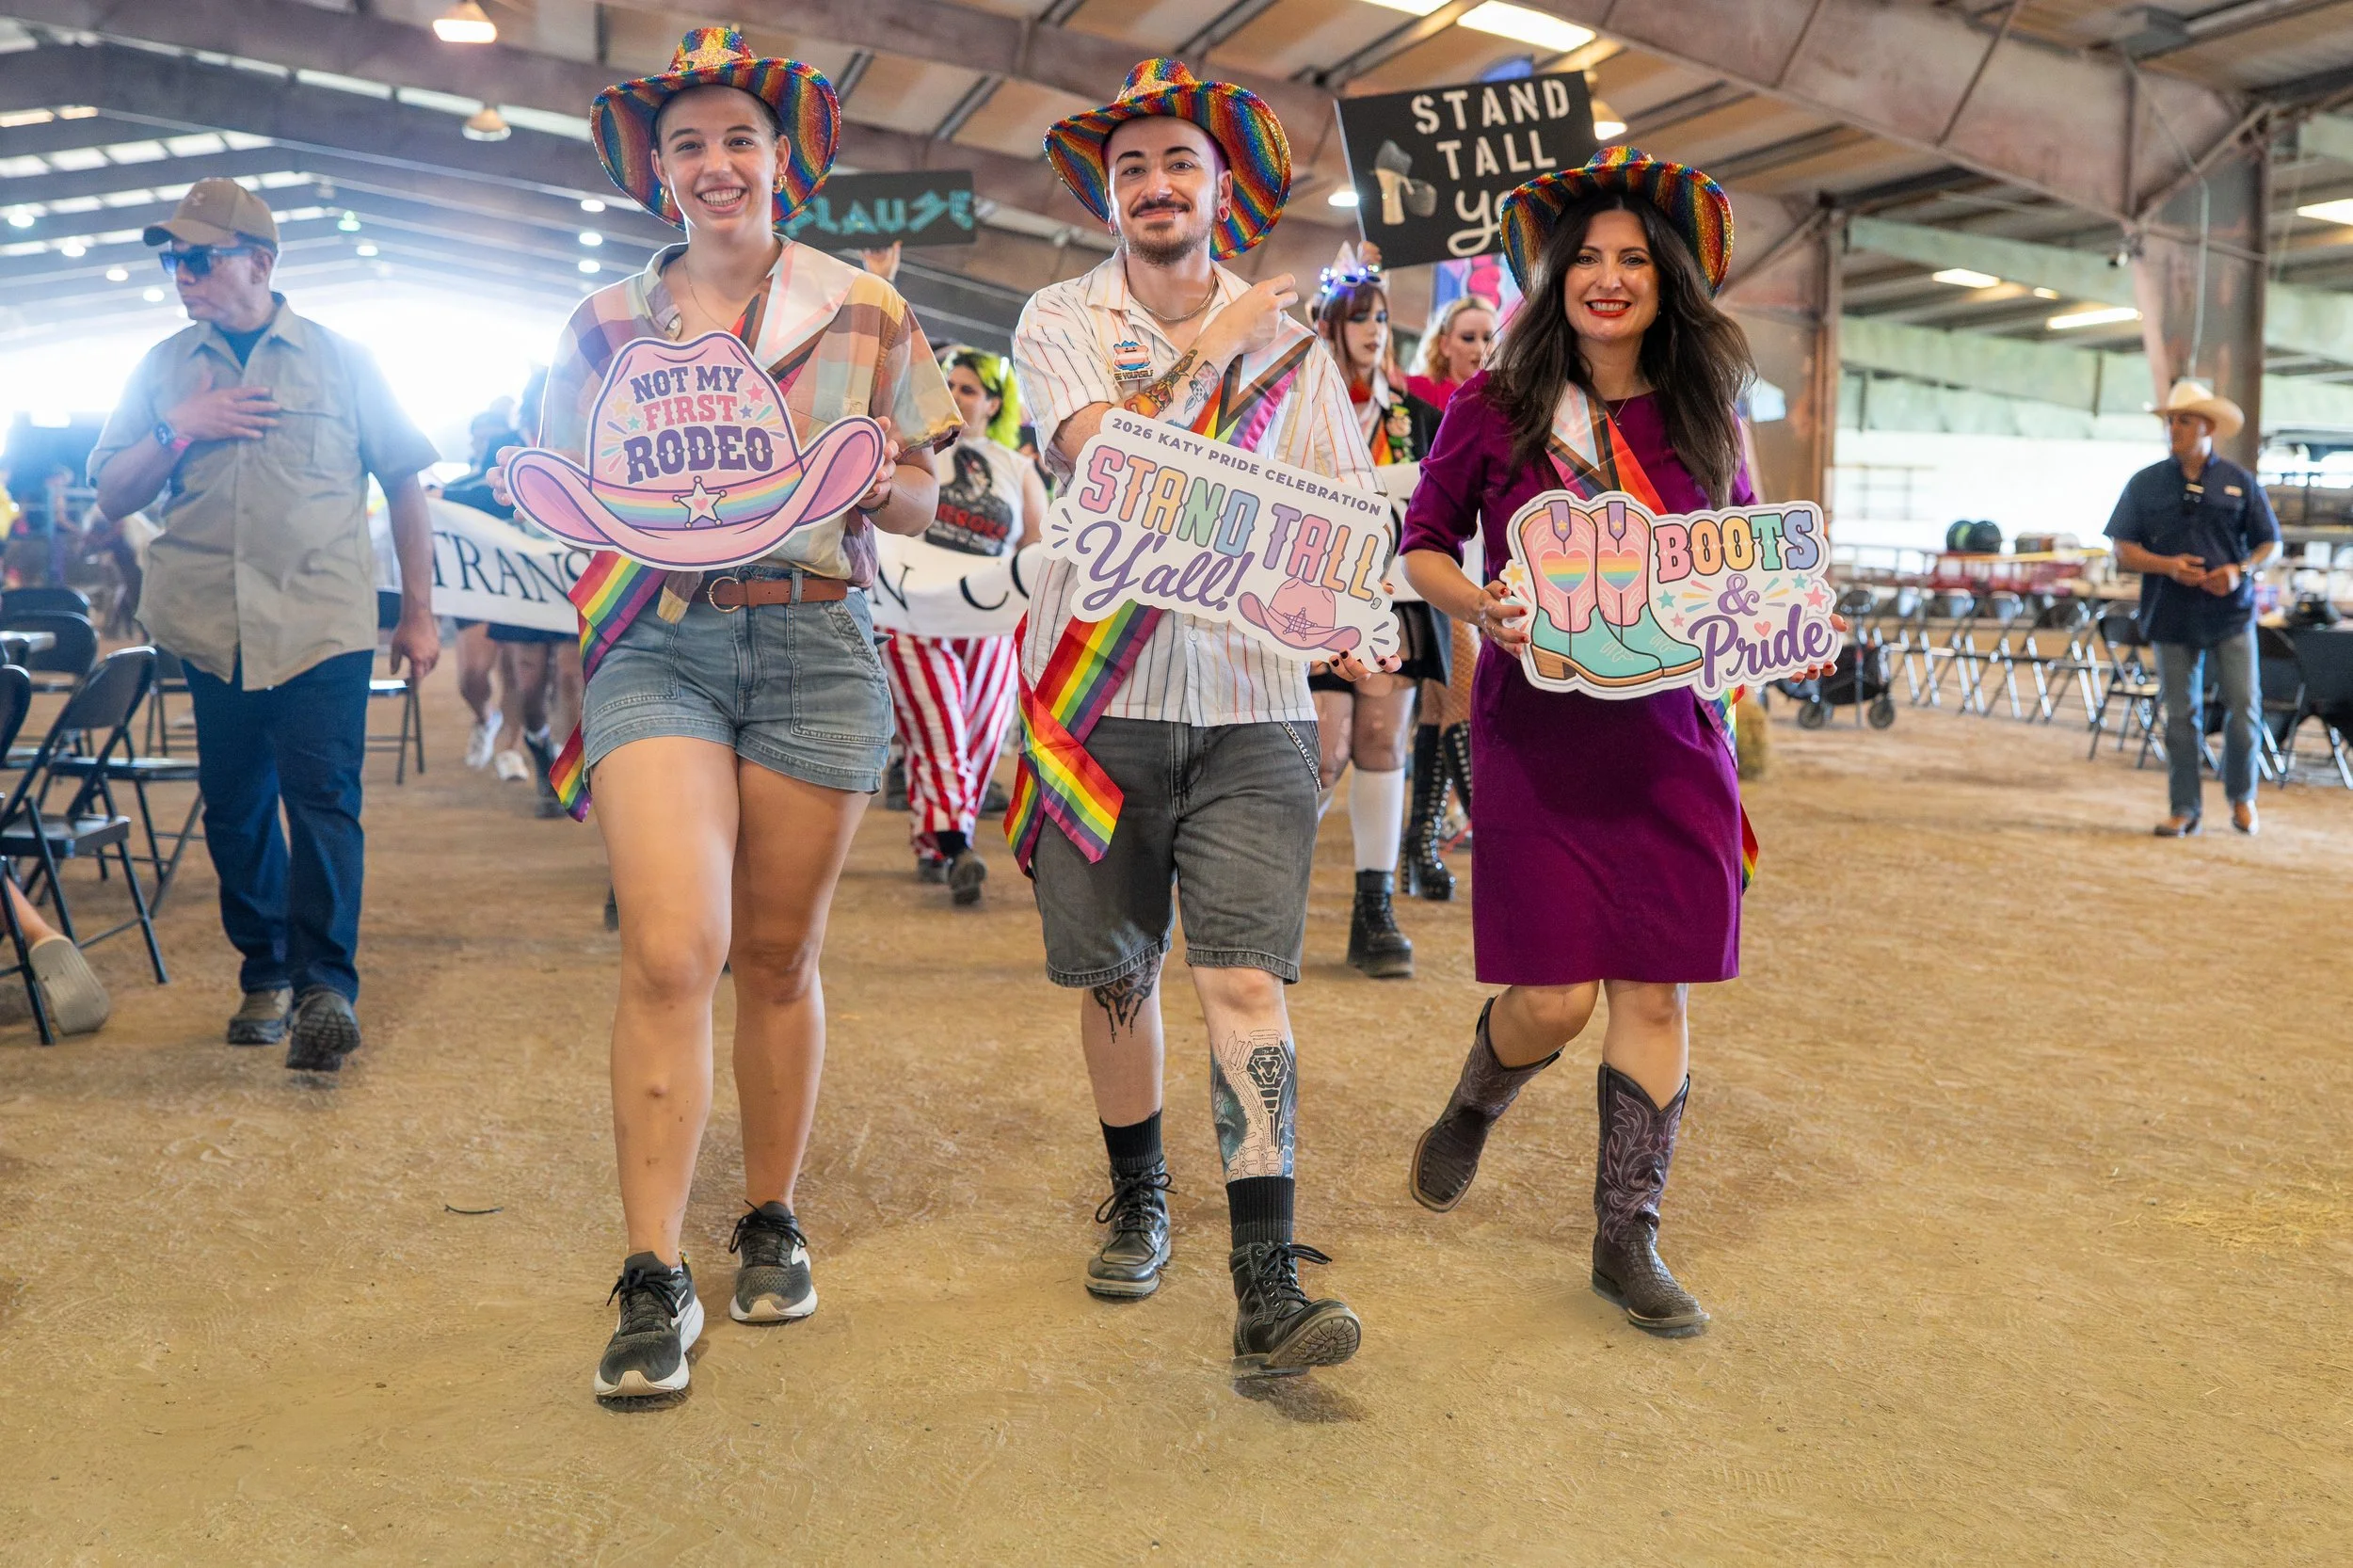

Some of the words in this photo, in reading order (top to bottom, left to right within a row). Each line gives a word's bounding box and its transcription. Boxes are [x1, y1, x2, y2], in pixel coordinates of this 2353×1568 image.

[1412, 80, 1569, 134] STAND
[1436, 130, 1557, 181] TALL
[630, 364, 688, 404] NOT
[696, 365, 744, 392] MY
[643, 394, 738, 431] FIRST
[623, 426, 774, 485] RODEO
[1112, 418, 1153, 440] 2026
[1158, 433, 1204, 456] KATY
[1208, 449, 1260, 476] PRIDE
[1265, 467, 1382, 517] CELEBRATION
[1079, 444, 1260, 558] STAND
[1075, 520, 1256, 612] Y'all!
[1654, 510, 1819, 583] BOOTS
[1717, 573, 1761, 616] &
[1687, 603, 1833, 688] Pride
